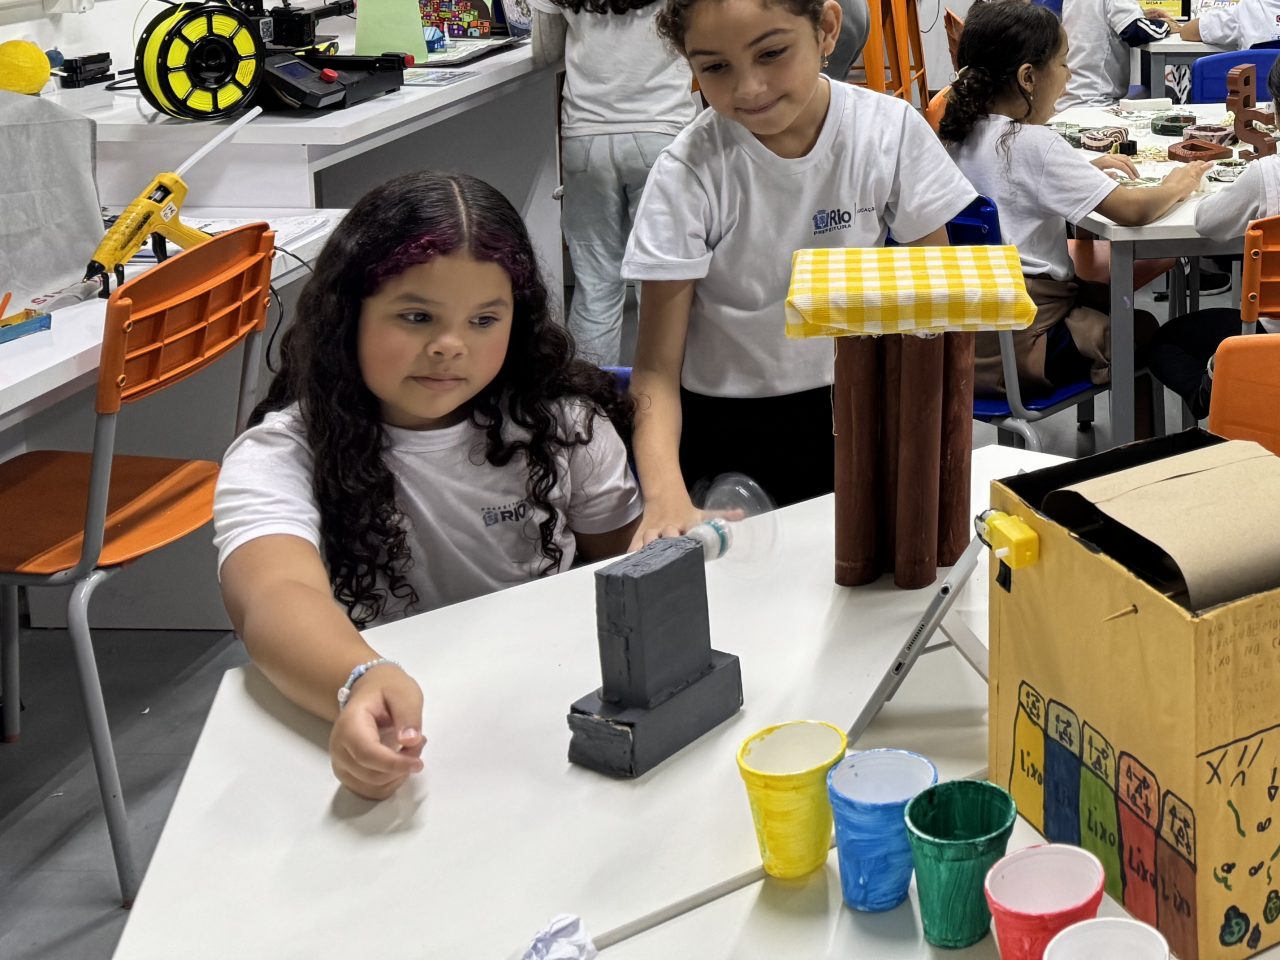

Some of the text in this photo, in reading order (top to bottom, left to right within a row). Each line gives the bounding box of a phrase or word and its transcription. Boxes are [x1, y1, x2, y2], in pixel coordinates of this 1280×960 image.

[829, 208, 852, 227] Rio
[500, 503, 526, 522] RIO
[1020, 749, 1043, 786] Lixo
[1087, 806, 1116, 848] Lixo
[1128, 844, 1157, 887] Lixo
